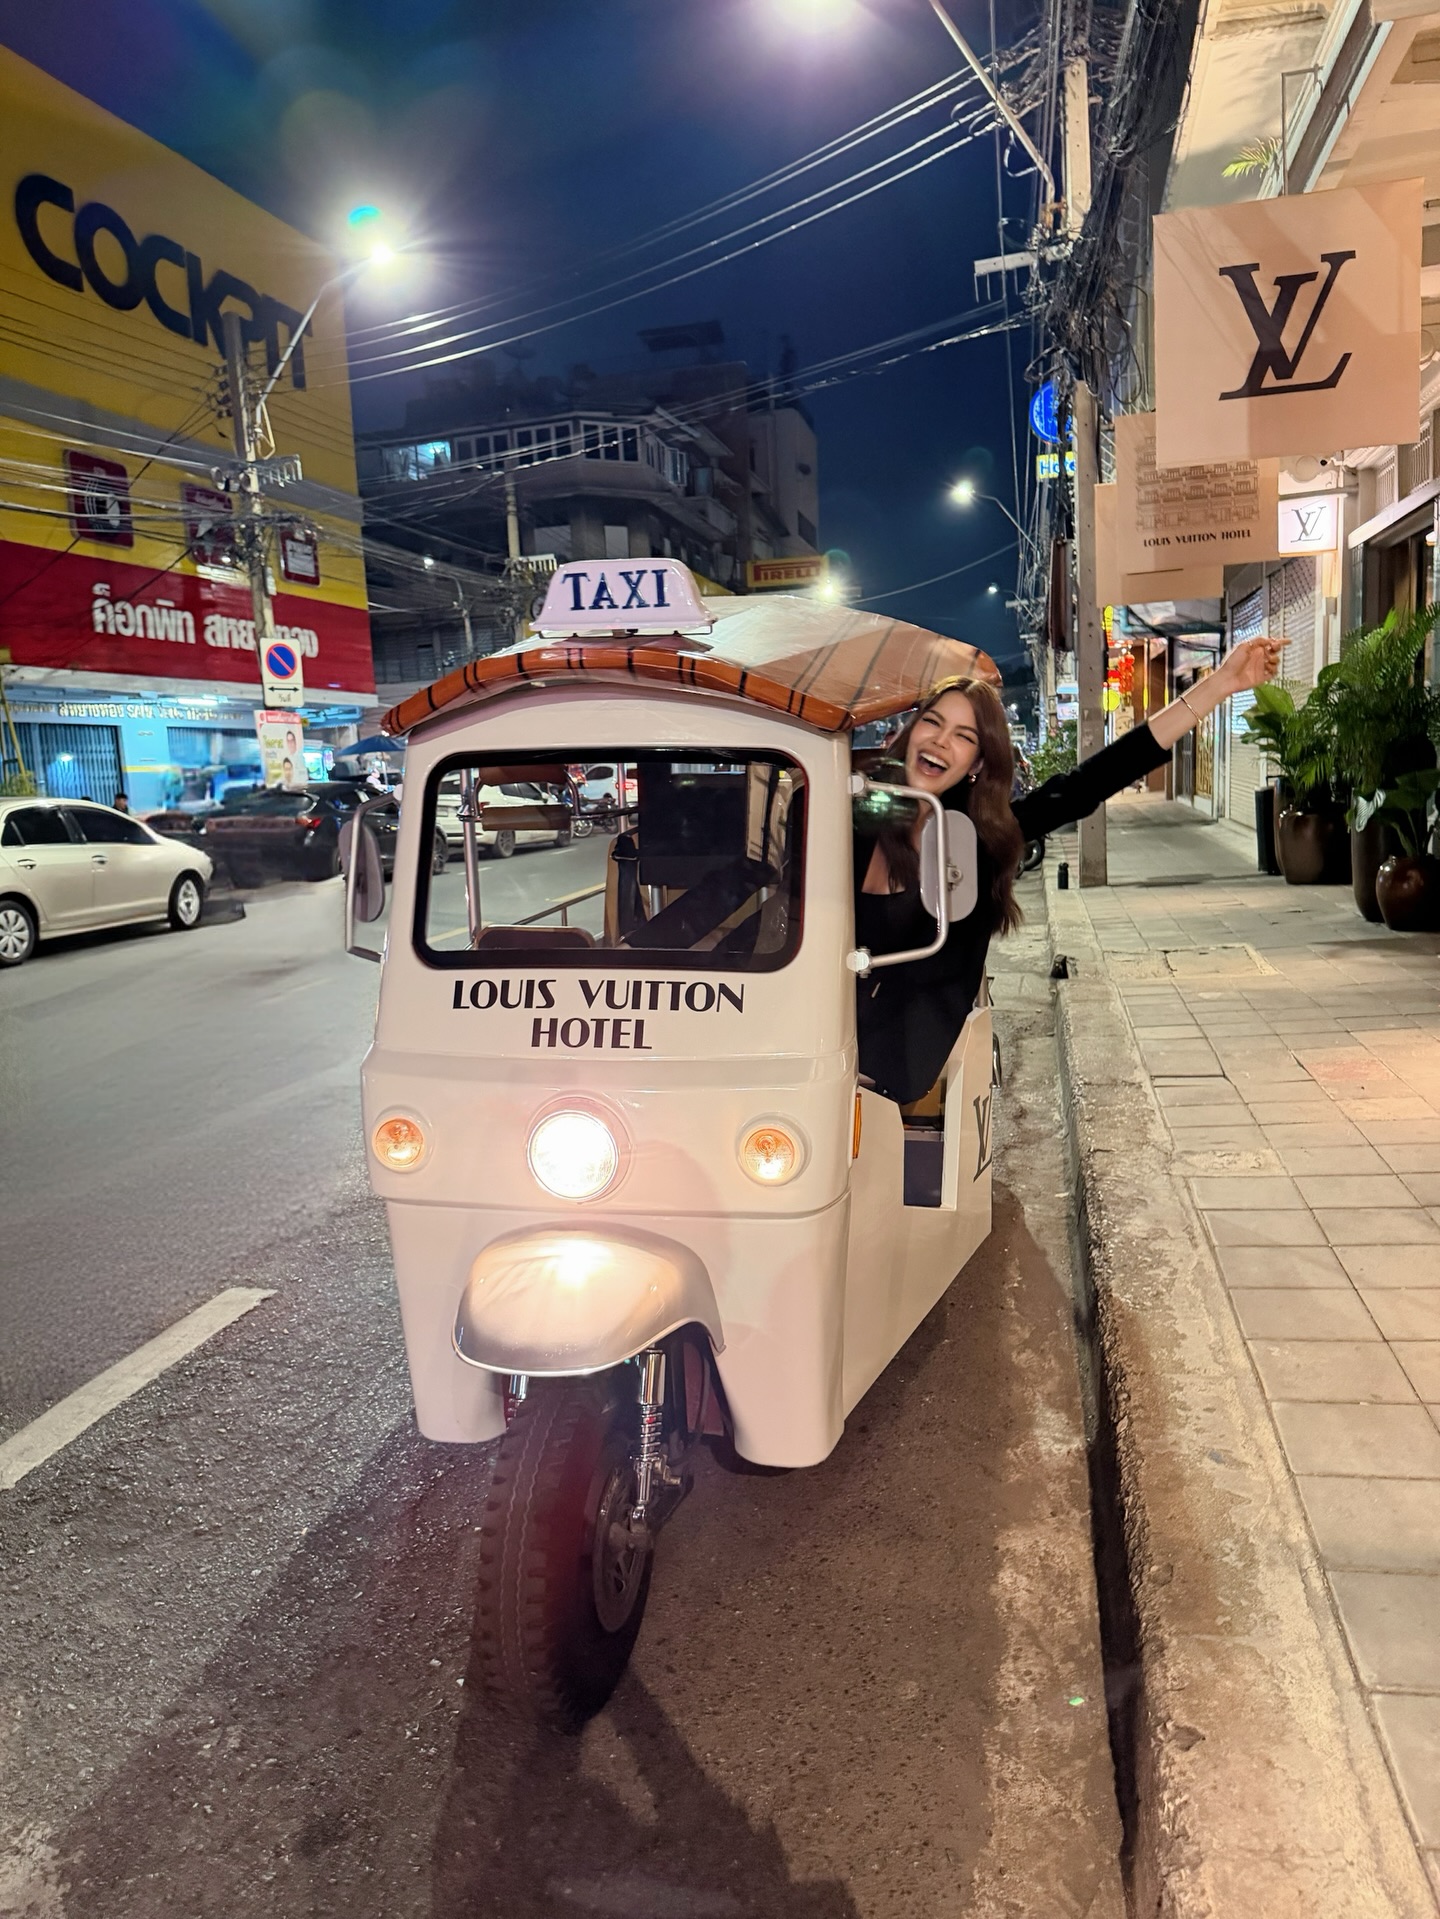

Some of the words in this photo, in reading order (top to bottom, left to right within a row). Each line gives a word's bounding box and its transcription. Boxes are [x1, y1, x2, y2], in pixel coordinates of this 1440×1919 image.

[15, 174, 312, 391] COCKPIT
[1219, 250, 1356, 401] LV
[1144, 537, 1171, 547] LOUIS
[1176, 532, 1217, 547] VUITTON
[1222, 529, 1251, 541] HOTEL
[561, 569, 671, 610] TAXI
[753, 560, 820, 582] PIRELLI
[92, 583, 196, 644] ค็อกพิท
[453, 979, 556, 1010] LOUIS
[578, 979, 744, 1014] VUITTON
[531, 1017, 652, 1049] HOTEL
